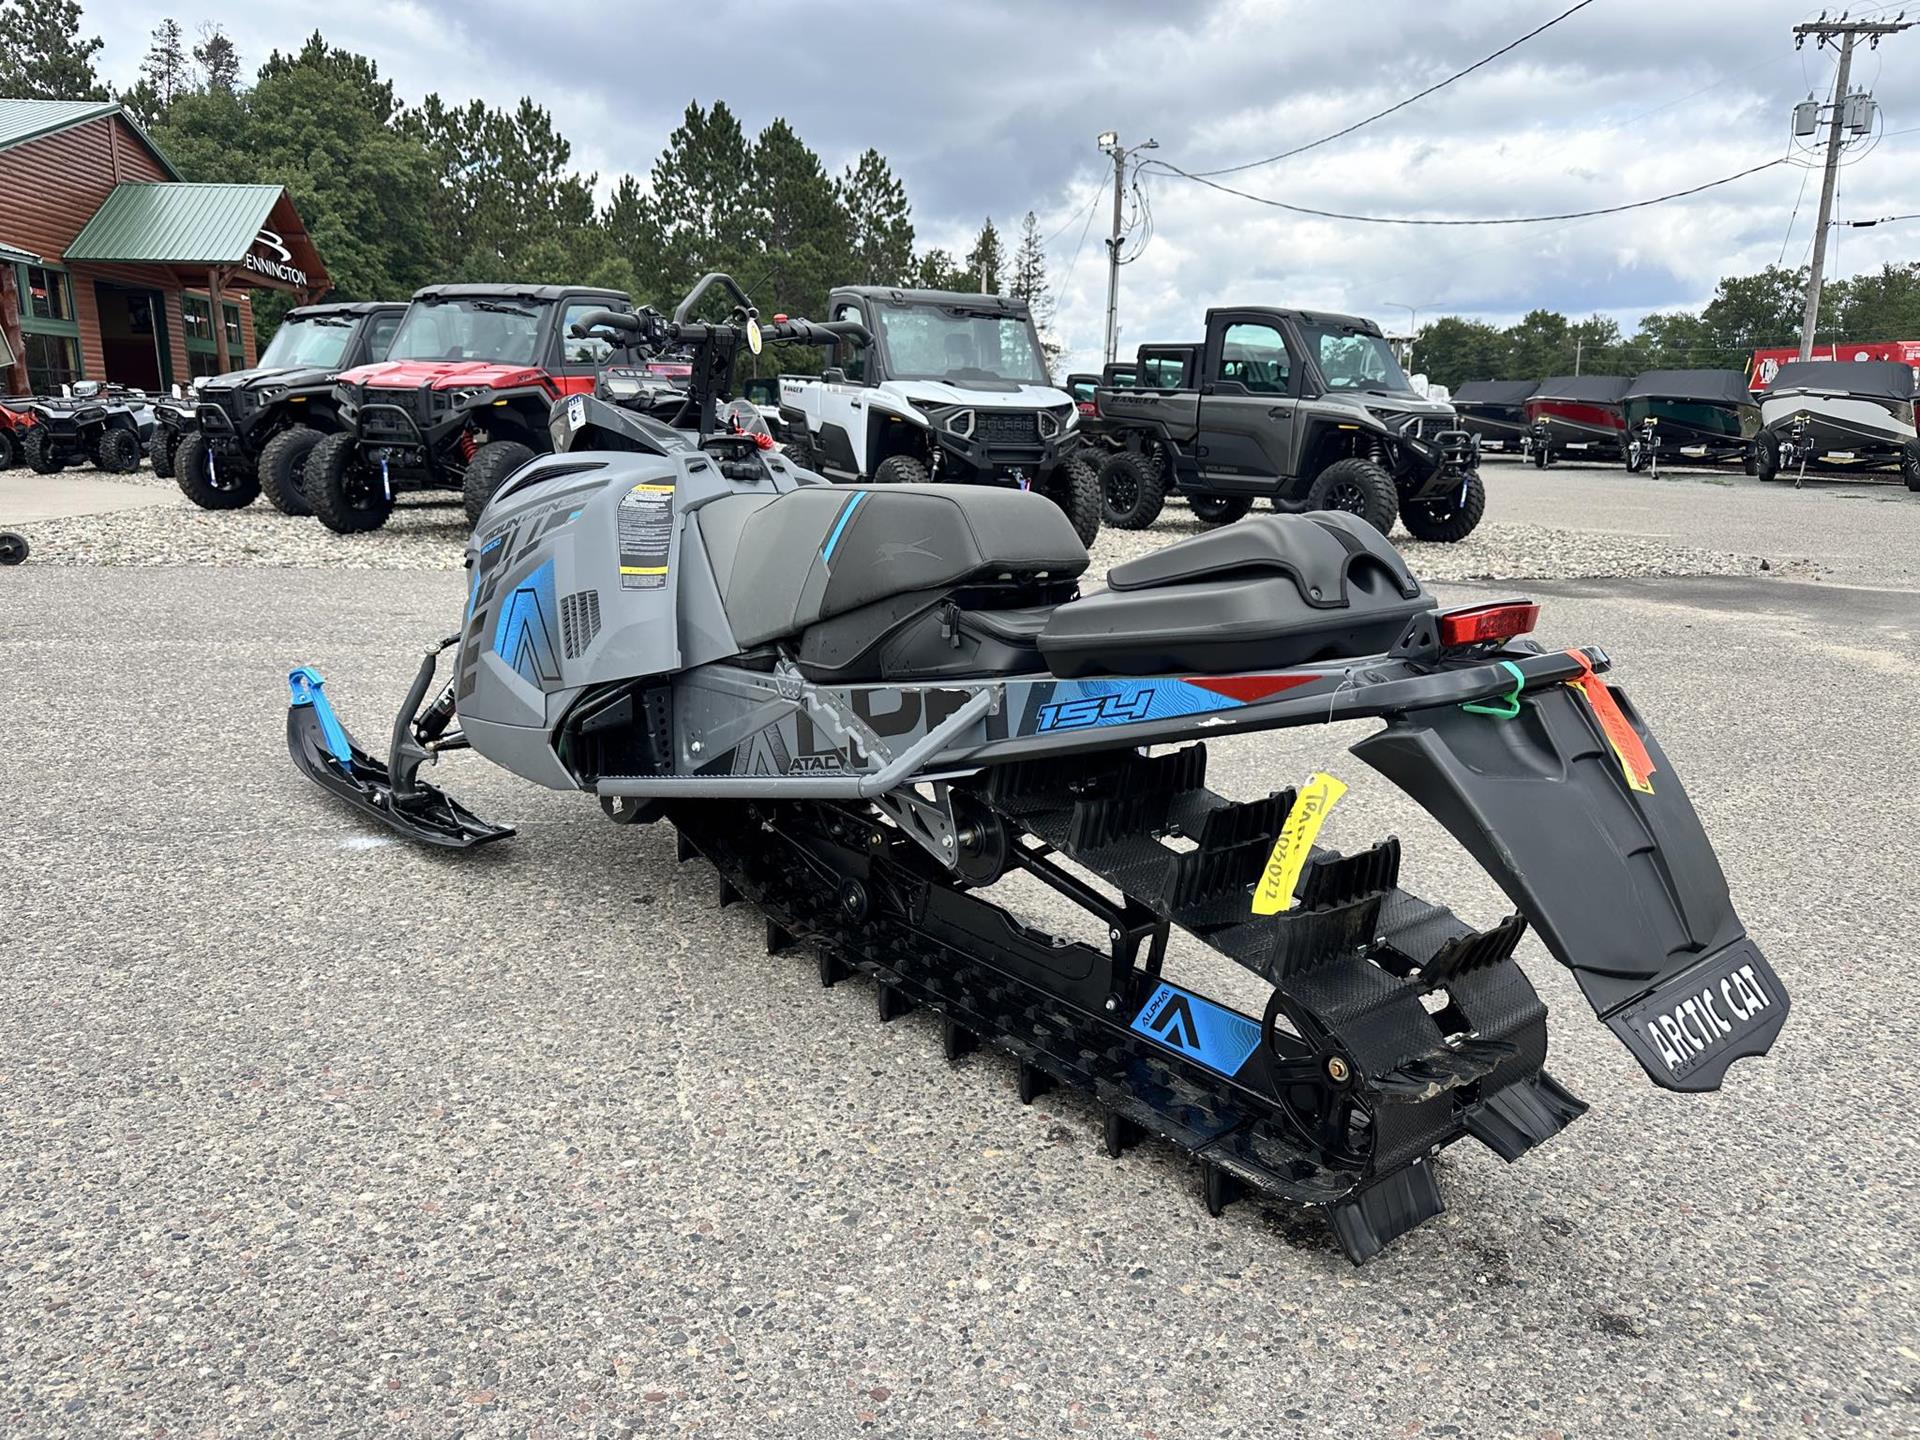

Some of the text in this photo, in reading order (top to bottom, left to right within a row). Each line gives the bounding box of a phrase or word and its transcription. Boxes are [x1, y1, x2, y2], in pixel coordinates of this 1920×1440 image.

[243, 253, 307, 286] ENNINGTON
[783, 385, 803, 393] RANGER
[1111, 396, 1160, 405] RANGER
[977, 420, 1034, 433] POLARIS
[1036, 688, 1156, 733] 154
[790, 756, 841, 771] ATAC
[1142, 988, 1170, 1028] ALPHA
[1647, 964, 1771, 1070] ARCTIC CAT
